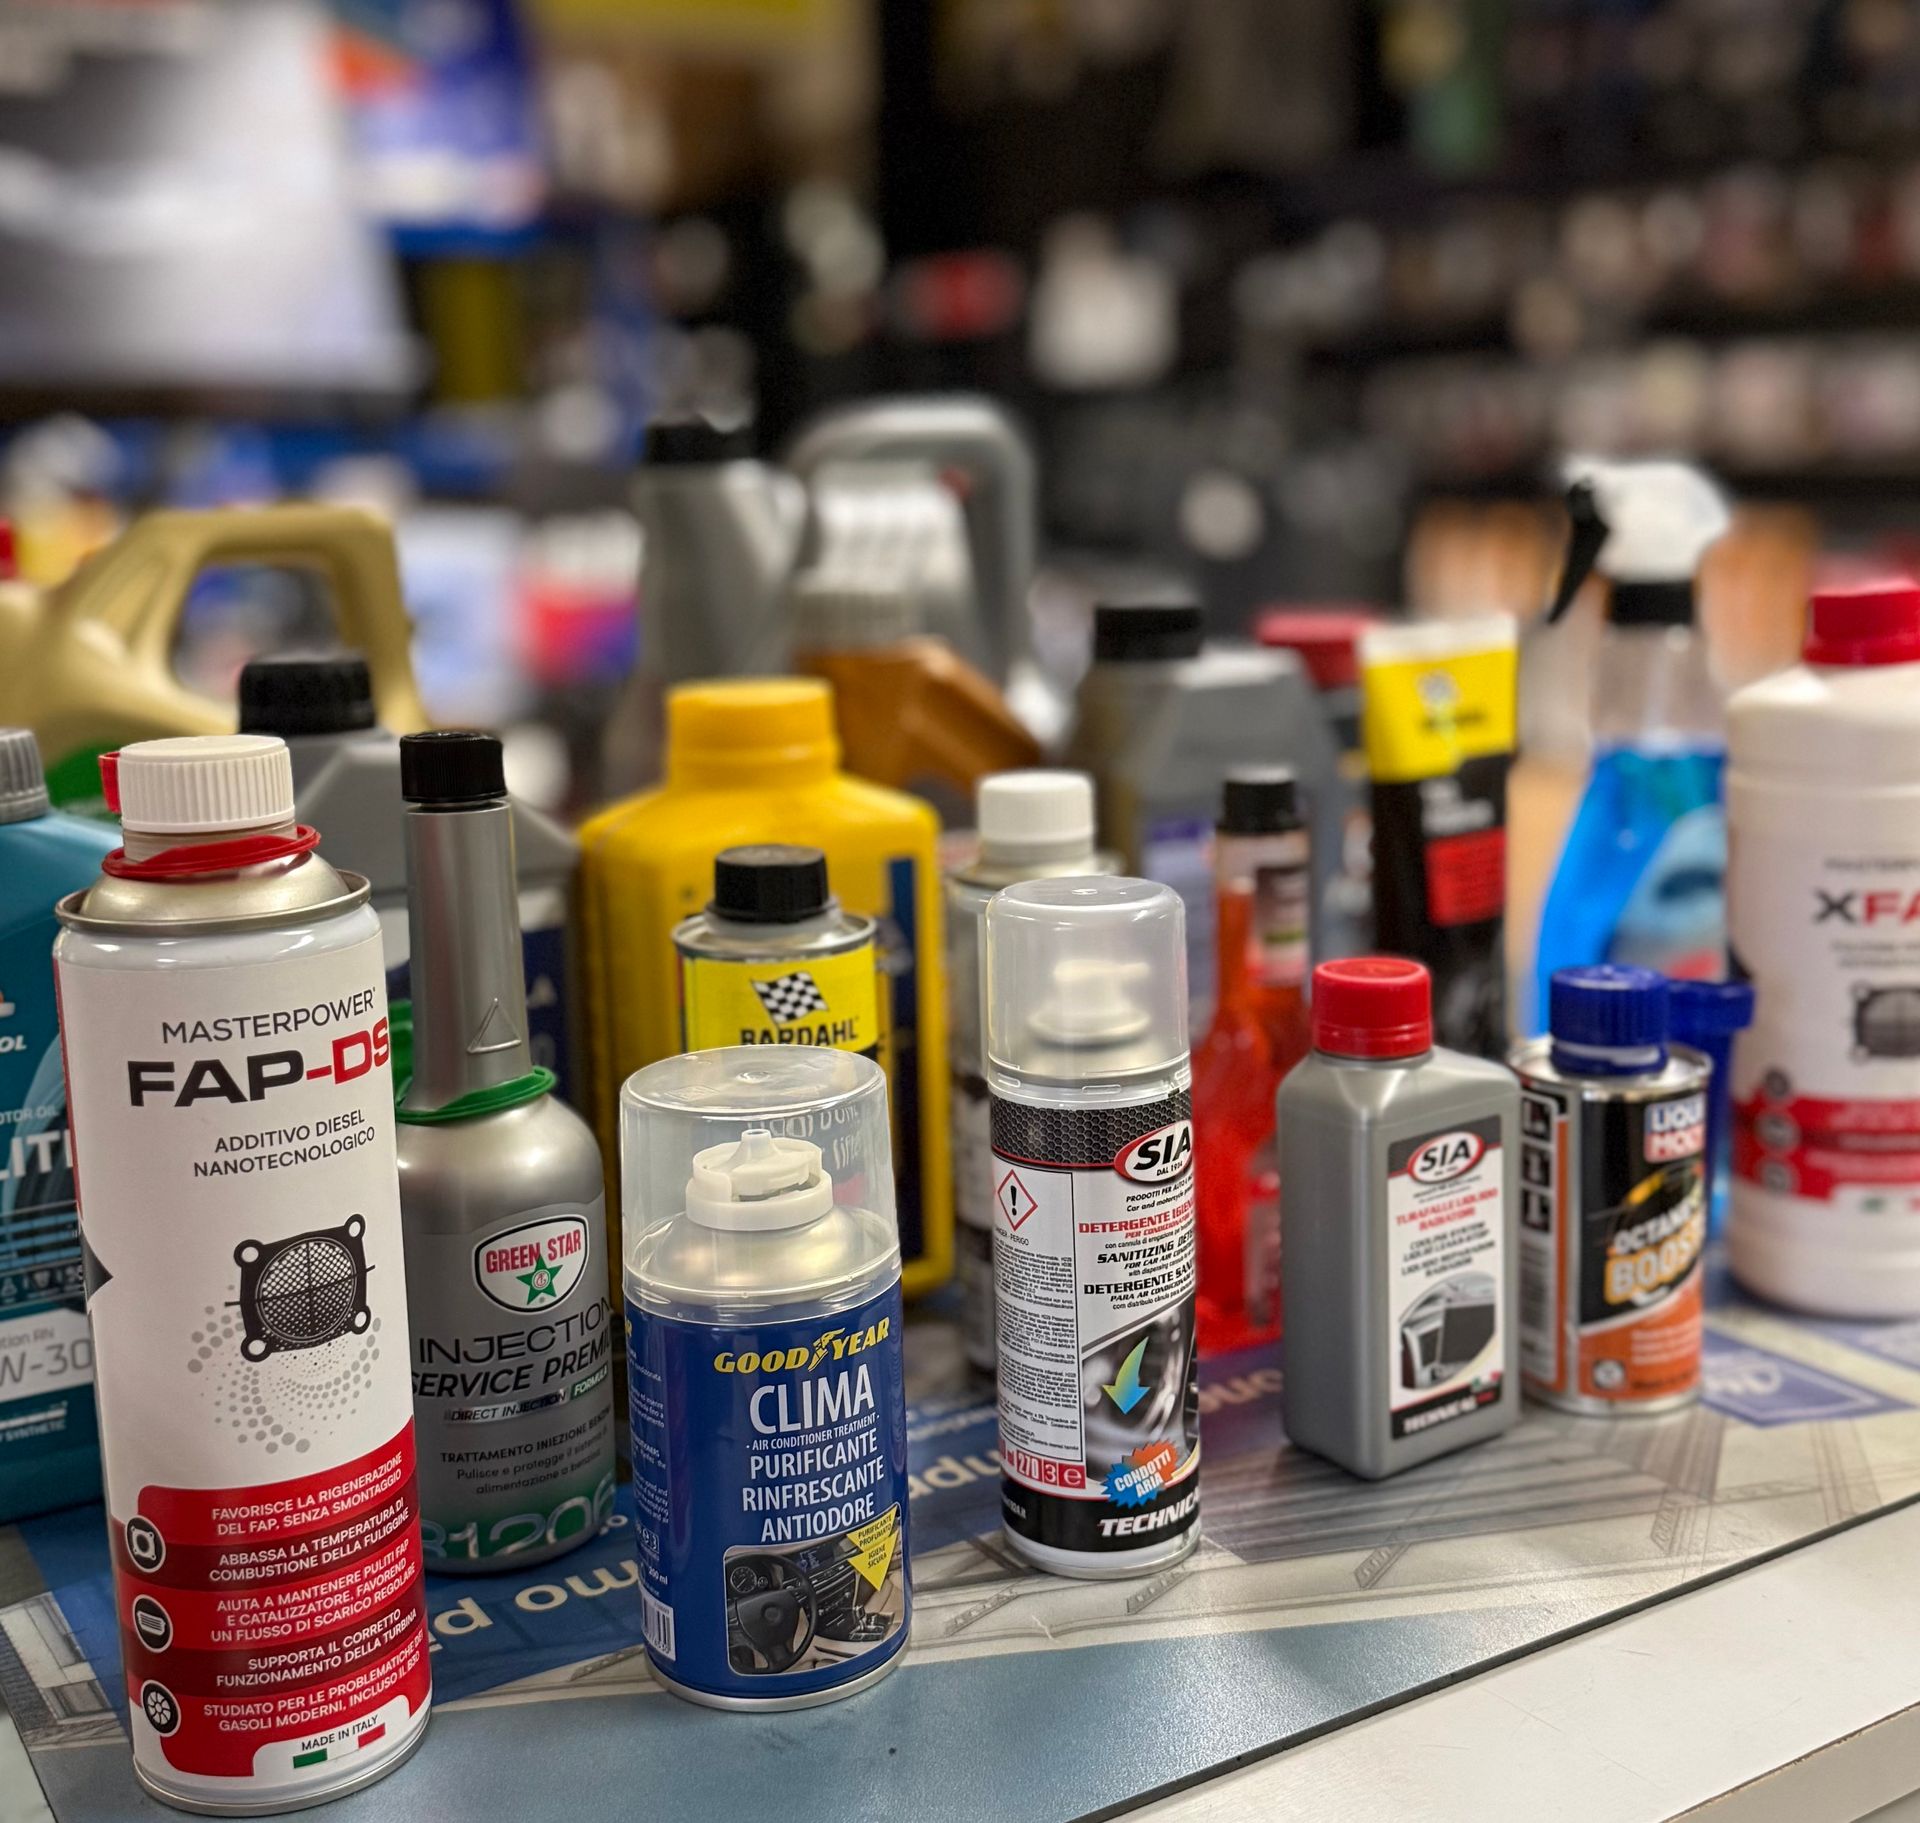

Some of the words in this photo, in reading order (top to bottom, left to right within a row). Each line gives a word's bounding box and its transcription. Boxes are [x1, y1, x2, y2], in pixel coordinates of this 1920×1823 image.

[163, 991, 374, 1044] MASTERPOWER
[740, 1018, 858, 1046] BARDAHL
[128, 1017, 389, 1107] FAP-DS
[215, 1125, 310, 1153] ADDITIVO
[316, 1109, 365, 1137] DIESEL
[1134, 1126, 1191, 1170] SIA
[194, 1127, 375, 1177] NANOTECNOLOGICO
[1157, 1167, 1169, 1176] DAL
[1420, 1139, 1471, 1172] SIA
[1126, 1191, 1160, 1202] PRODOTTI
[1162, 1187, 1172, 1195] PER
[1126, 1204, 1139, 1212] Car
[1142, 1200, 1155, 1209] and
[1010, 1233, 1029, 1246] PERIGO
[1079, 1211, 1170, 1233] DETERGENTE
[1125, 1231, 1141, 1240] PER
[487, 1243, 541, 1273] GREEN
[548, 1229, 581, 1261] STAR
[1098, 1241, 1174, 1264] SANITIZING
[1118, 1239, 1140, 1248] cannula
[1143, 1258, 1158, 1266] CAR
[1084, 1271, 1173, 1295] DETERGENTE
[1110, 1292, 1134, 1302] PARA
[452, 1407, 499, 1422] DIRECT
[750, 1363, 874, 1434] CLIMA
[440, 1444, 533, 1463] TRATTAMENTO
[537, 1423, 586, 1451] INIEZIONE
[752, 1439, 769, 1450] AIR
[771, 1430, 832, 1449] CONDITIONER
[834, 1413, 876, 1438] TREATMENT
[457, 1467, 498, 1480] Pulisce
[513, 1452, 564, 1474] protegge
[751, 1428, 878, 1480] PURIFICANTE
[1045, 1464, 1056, 1483] 3
[1114, 1449, 1171, 1492] CONDOTTI
[212, 1499, 294, 1520] FAVORISCE
[297, 1494, 315, 1508] LA
[318, 1451, 402, 1503] RIGENERAZIONE
[218, 1523, 246, 1536] DEL
[283, 1506, 330, 1527] SENZA
[333, 1468, 401, 1514] SMONTAGGIO
[476, 1472, 559, 1494] alimentazione
[743, 1455, 884, 1512] RINFRESCANTE
[1136, 1472, 1163, 1498] ARIA
[220, 1547, 287, 1566] ABBASSA
[291, 1543, 309, 1557] LA
[312, 1505, 395, 1551] TEMPERATURA
[396, 1496, 404, 1511] DI
[761, 1492, 874, 1543] ANTIODORE
[209, 1555, 318, 1581] COMBUSTIONE
[321, 1540, 361, 1564] DELLA
[364, 1507, 409, 1547] FULIGGINE
[217, 1598, 260, 1612] AIUTA
[264, 1596, 274, 1608] A
[278, 1571, 361, 1606] MANTENERE
[364, 1551, 395, 1578] PULITI
[395, 1539, 409, 1559] FAP
[211, 1630, 232, 1642] UN
[236, 1623, 292, 1641] FLUSSO
[296, 1619, 311, 1633] DI
[314, 1597, 371, 1628] SCARICO
[374, 1561, 415, 1604] REGOLARE
[227, 1615, 236, 1626] E
[216, 1655, 341, 1687] FUNZIONAMENTO
[344, 1637, 381, 1663] DELLA
[383, 1608, 416, 1644] TURBINA
[248, 1646, 325, 1670] SUPPORTA
[328, 1641, 340, 1653] IL
[342, 1608, 401, 1648] CORRETTO
[203, 1702, 273, 1717] STUDIATO
[277, 1696, 305, 1712] PER
[309, 1690, 325, 1704] LE
[328, 1641, 414, 1698] PROBLEMATICHE
[219, 1717, 272, 1731] GASOLI
[350, 1672, 398, 1706] INCLUSO
[399, 1665, 407, 1679] IL
[301, 1733, 336, 1751] MADE
[338, 1730, 350, 1741] IN
[352, 1715, 379, 1735] ITALY
